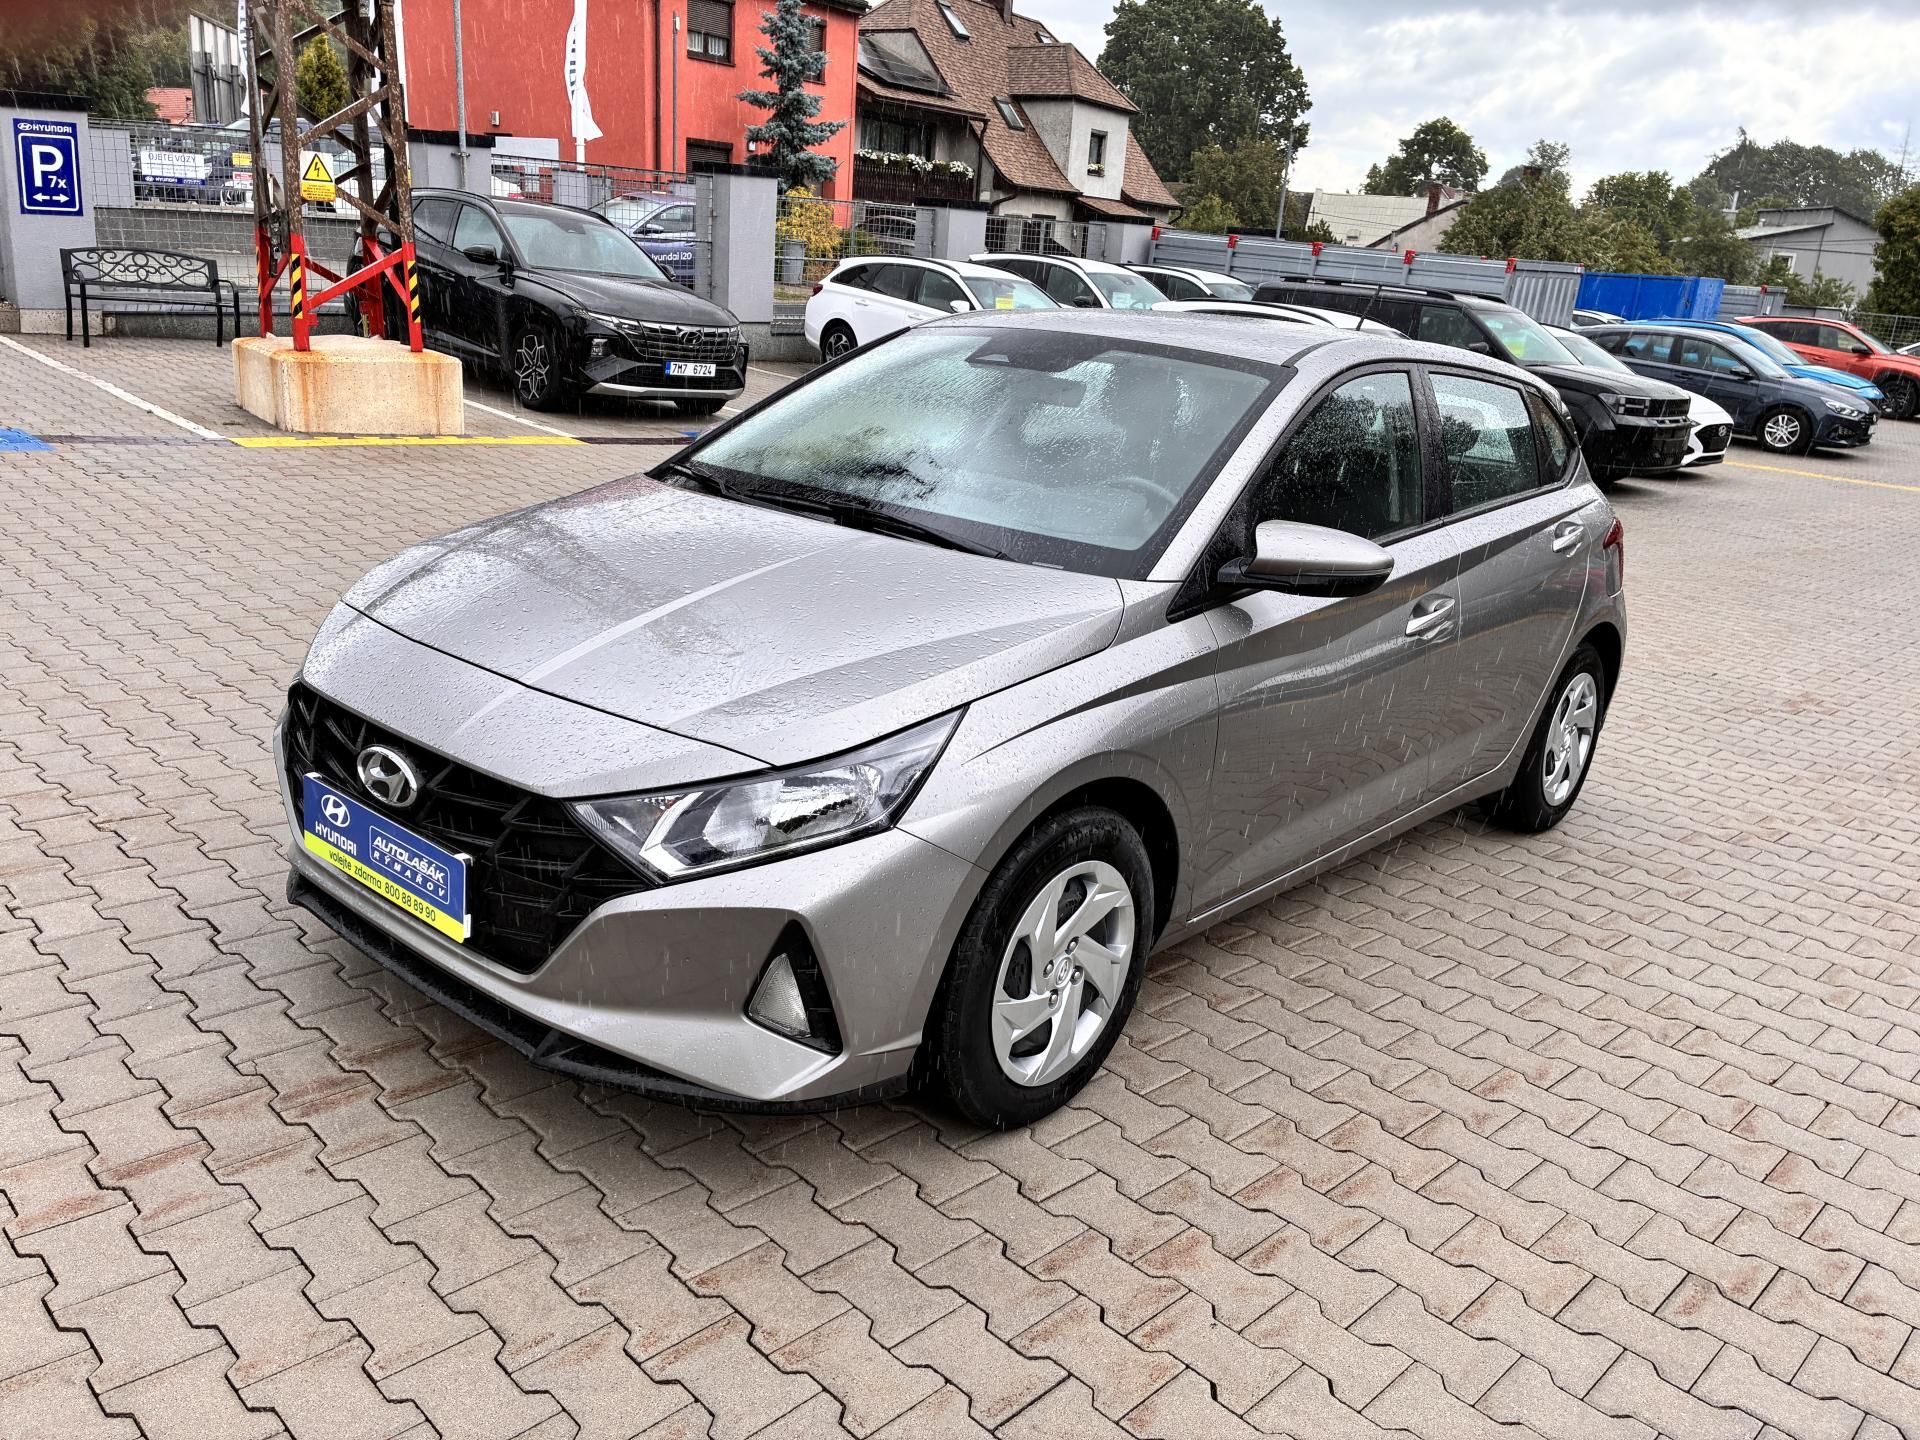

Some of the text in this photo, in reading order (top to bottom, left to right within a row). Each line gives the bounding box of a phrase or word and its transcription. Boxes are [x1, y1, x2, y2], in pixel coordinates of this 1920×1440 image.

[32, 123, 72, 133] HYUNDAI
[31, 144, 64, 188] P
[47, 175, 67, 189] 7x
[680, 251, 692, 260] i20
[672, 363, 712, 375] 7M7 6724
[315, 820, 357, 857] HYUNDAI
[373, 836, 446, 884] AUTOLAŠÁK
[328, 849, 436, 922] volejte zdarma 800 88 89 90
